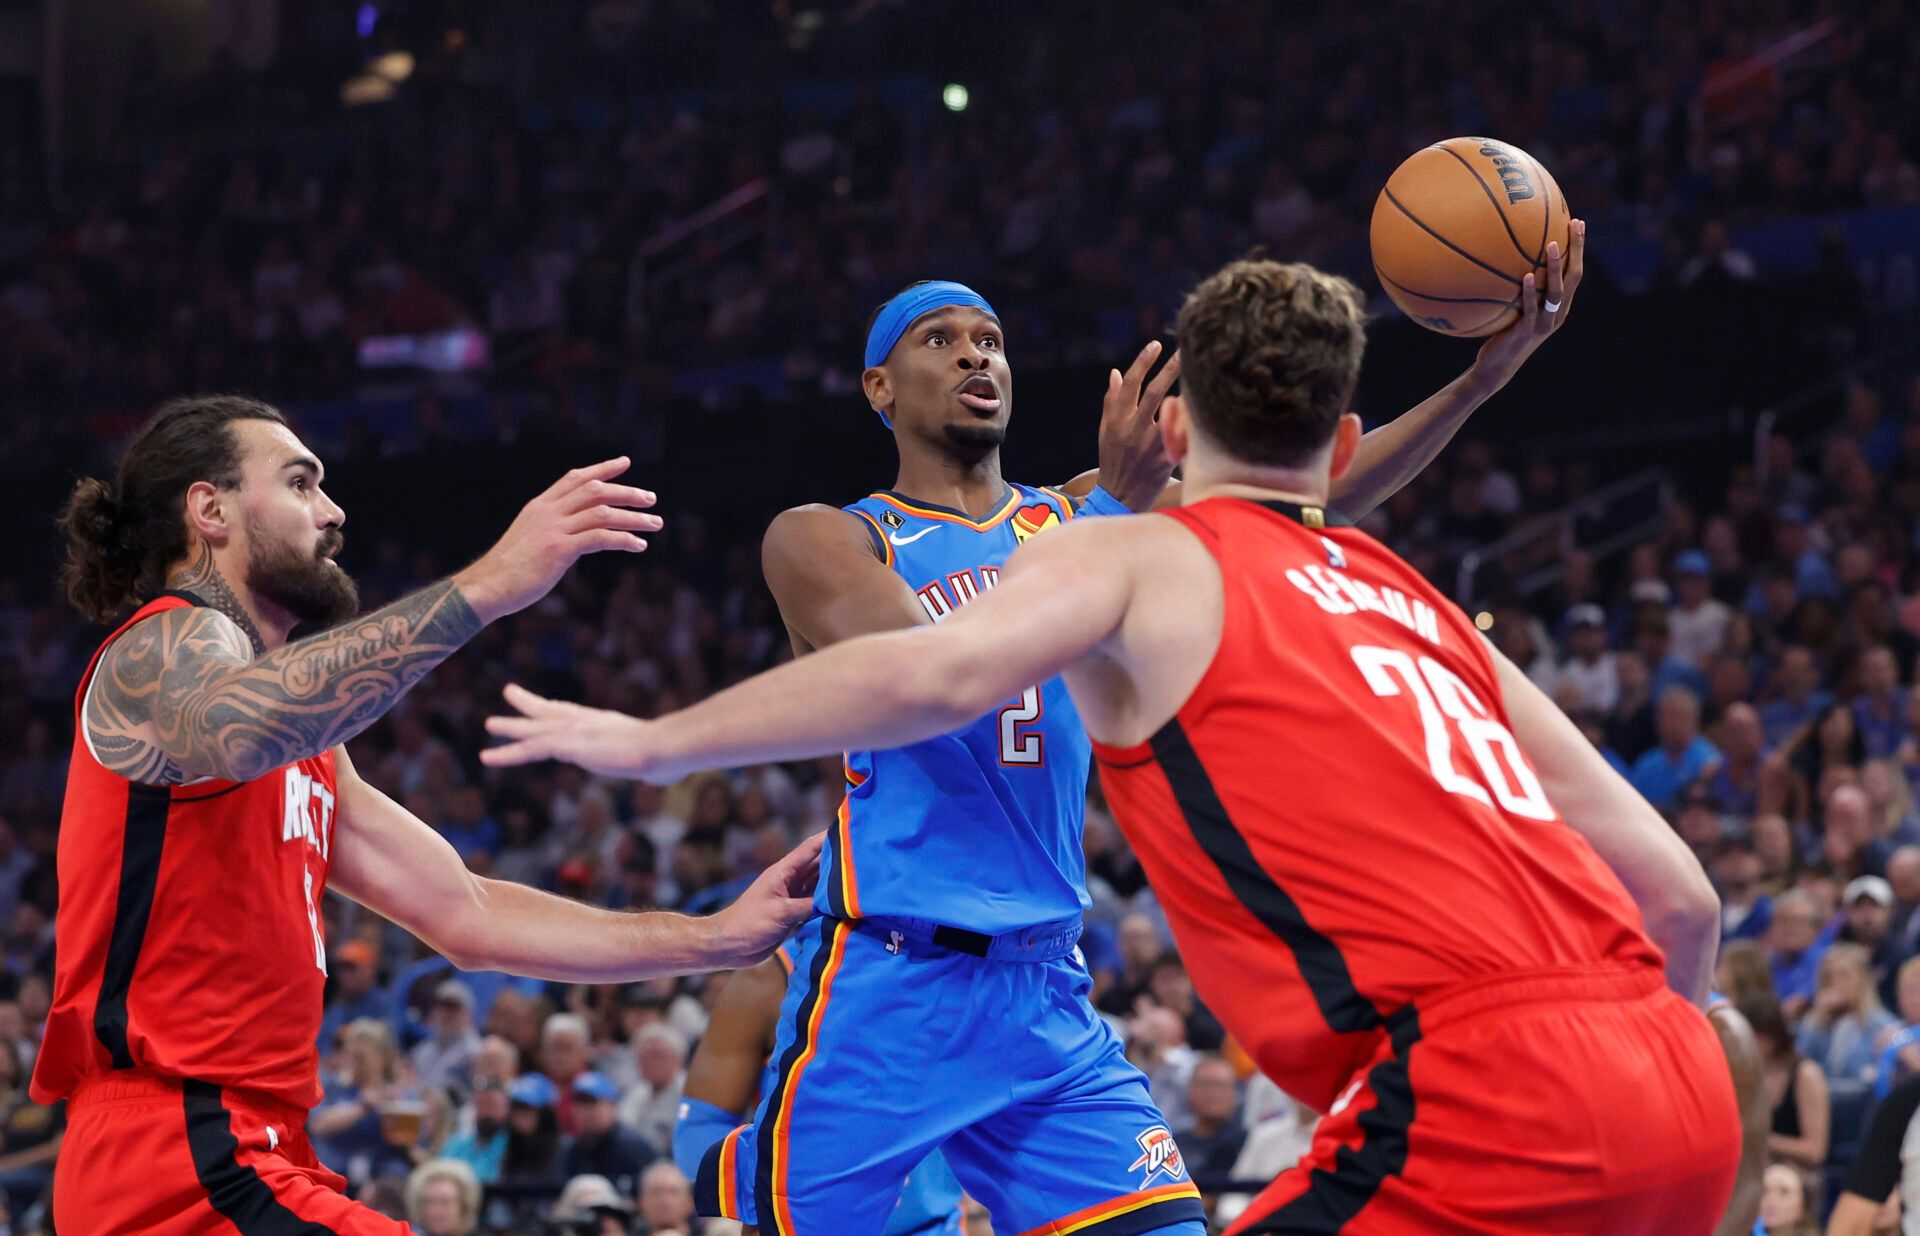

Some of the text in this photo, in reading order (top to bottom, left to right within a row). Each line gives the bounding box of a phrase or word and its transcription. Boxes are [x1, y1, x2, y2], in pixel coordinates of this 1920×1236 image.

[999, 684, 1045, 767] 2
[1350, 644, 1556, 822] 28
[1148, 1137, 1177, 1173] OKC
